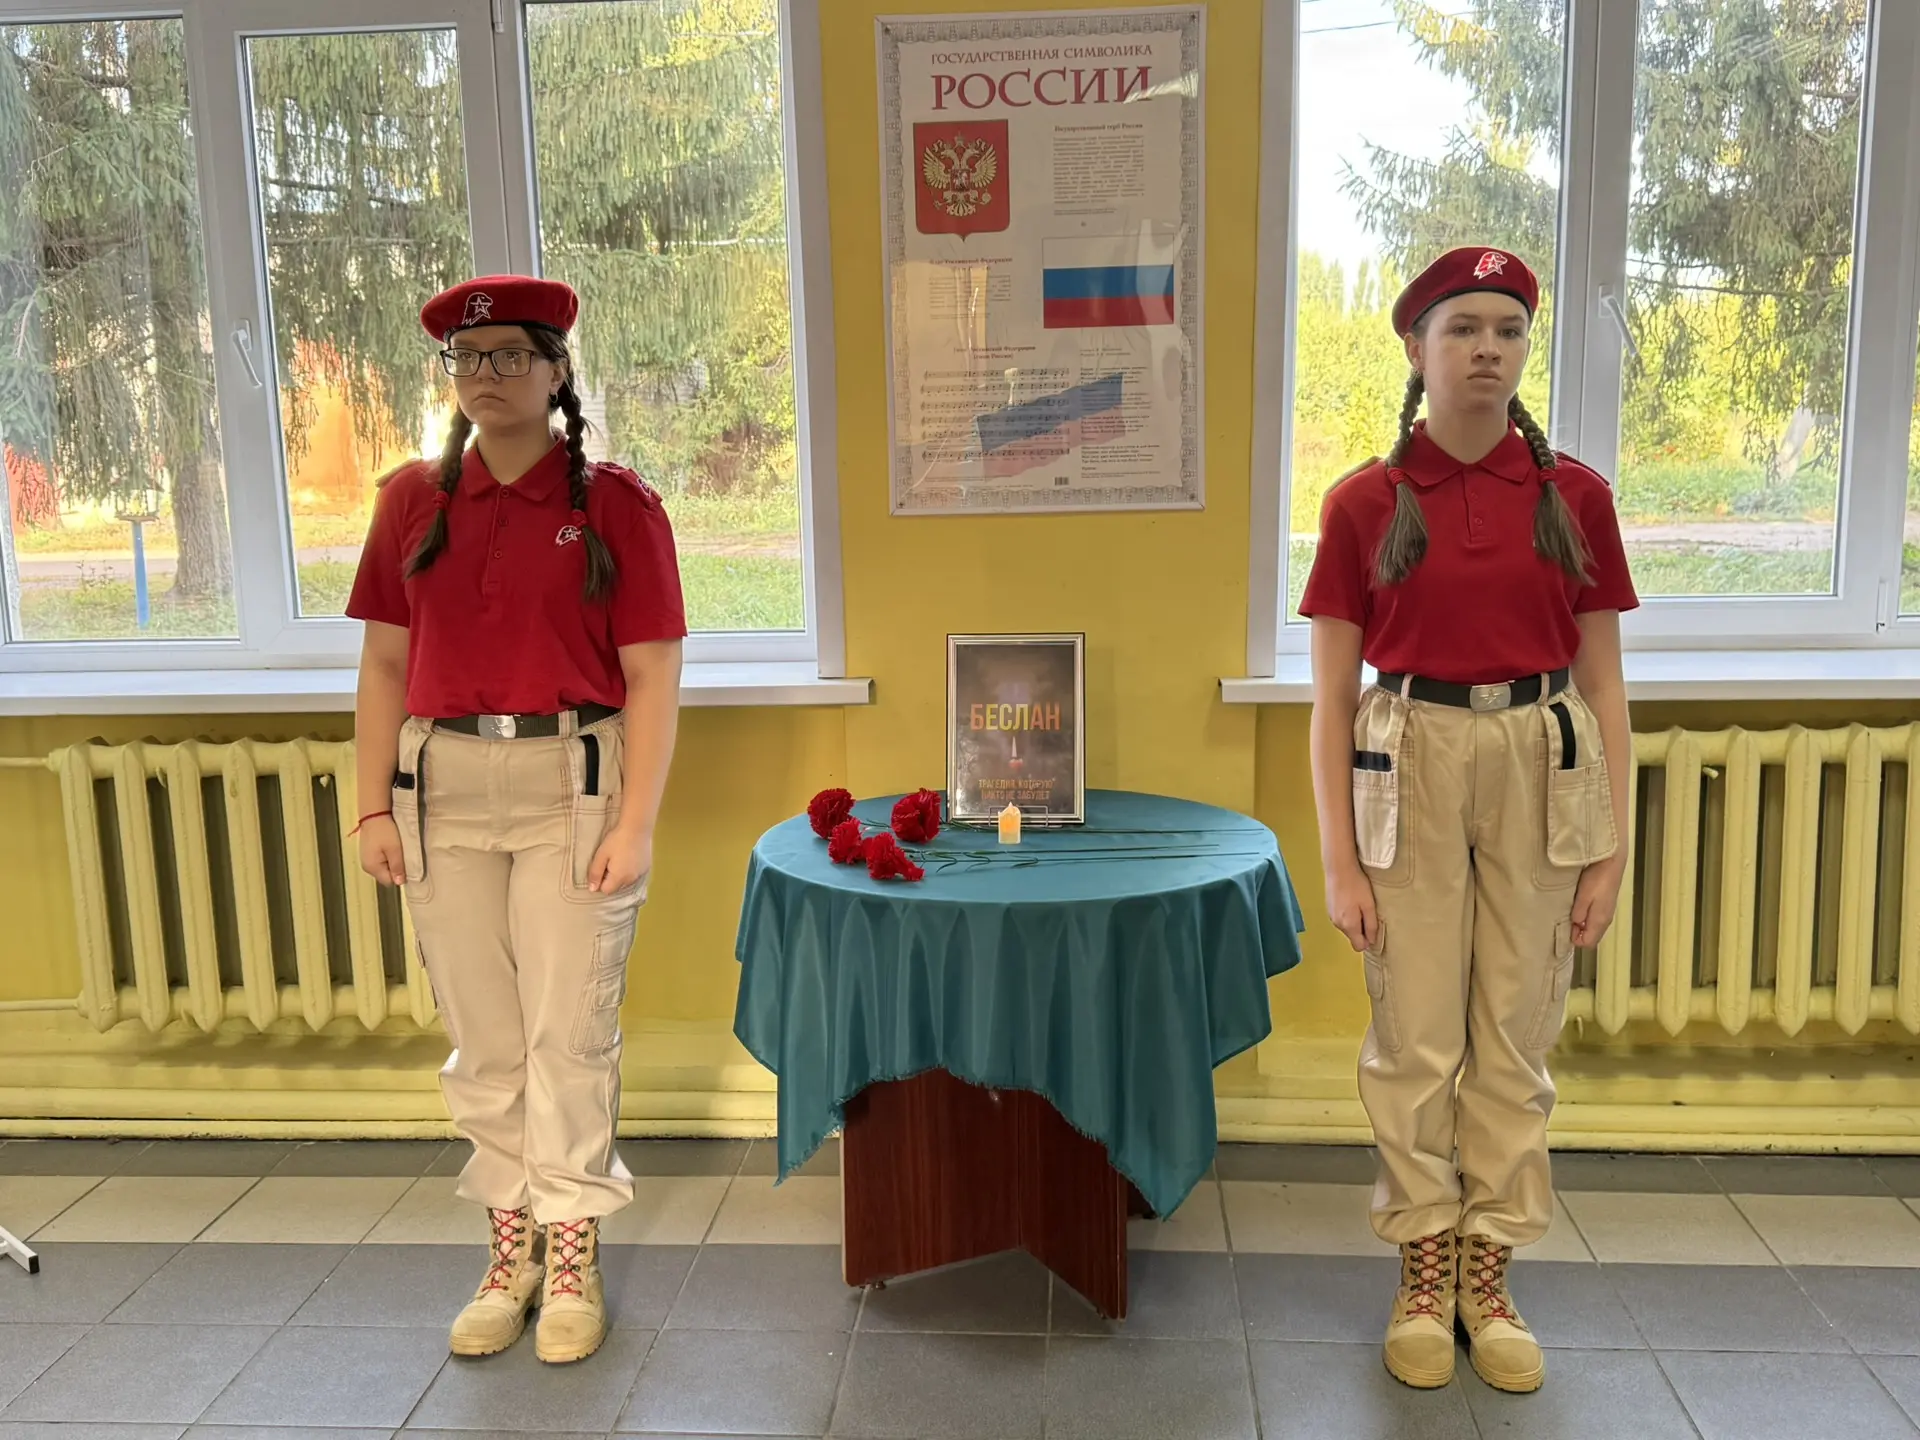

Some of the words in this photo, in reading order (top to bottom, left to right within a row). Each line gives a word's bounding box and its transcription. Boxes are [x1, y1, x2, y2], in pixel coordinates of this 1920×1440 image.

[931, 48, 1060, 65] ГОСУДАРСТВЕННАЯ
[1063, 44, 1153, 60] СИМВОЛИКА
[930, 65, 1153, 111] РОССИИ
[970, 703, 1061, 730] БЕСЛАН
